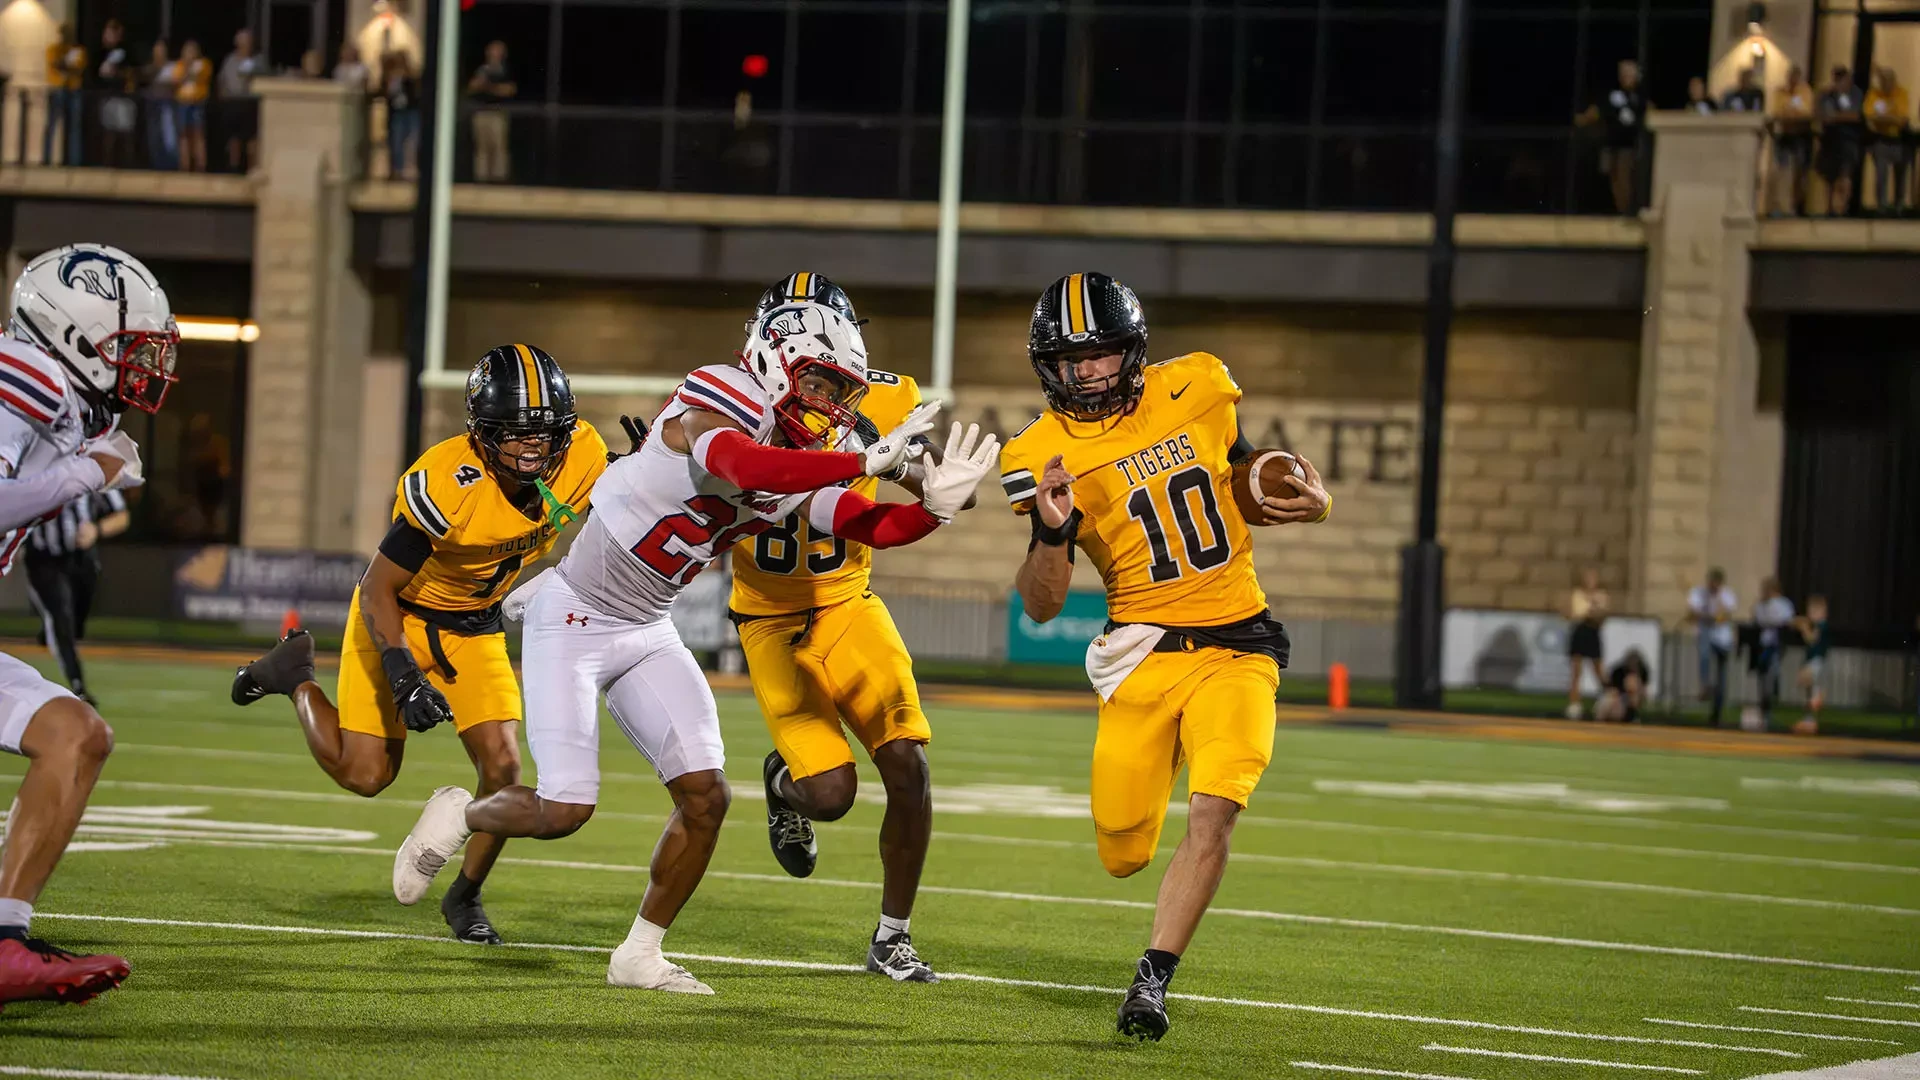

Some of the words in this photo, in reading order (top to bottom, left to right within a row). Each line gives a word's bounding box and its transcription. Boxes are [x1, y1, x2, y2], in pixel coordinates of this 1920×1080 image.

[453, 464, 483, 488] 4
[1116, 433, 1197, 486] TIGERS
[754, 511, 847, 576] 85
[1126, 464, 1232, 583] 10
